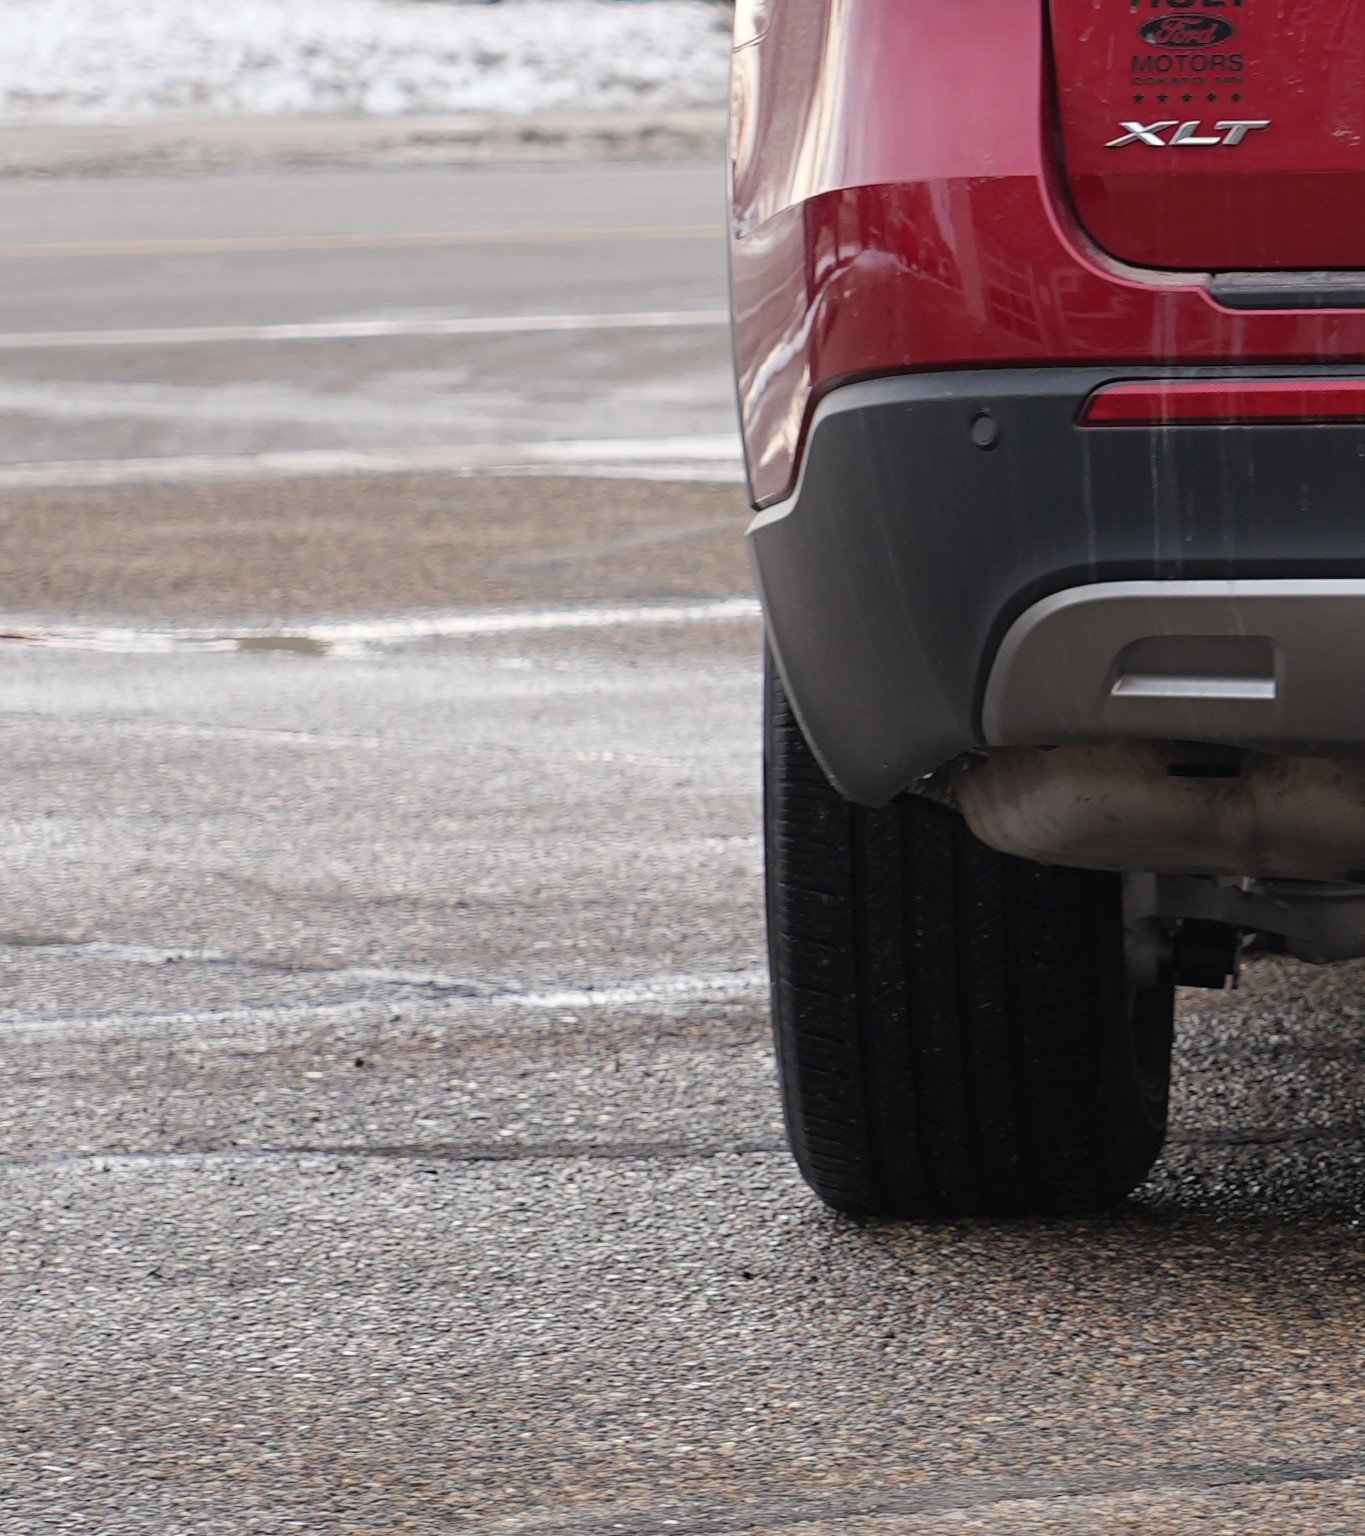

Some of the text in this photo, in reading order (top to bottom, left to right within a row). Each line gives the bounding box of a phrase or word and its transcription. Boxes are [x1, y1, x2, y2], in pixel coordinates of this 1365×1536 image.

[1153, 16, 1220, 44] Ford
[1131, 53, 1245, 73] MOTORS
[1104, 119, 1272, 147] XLT
